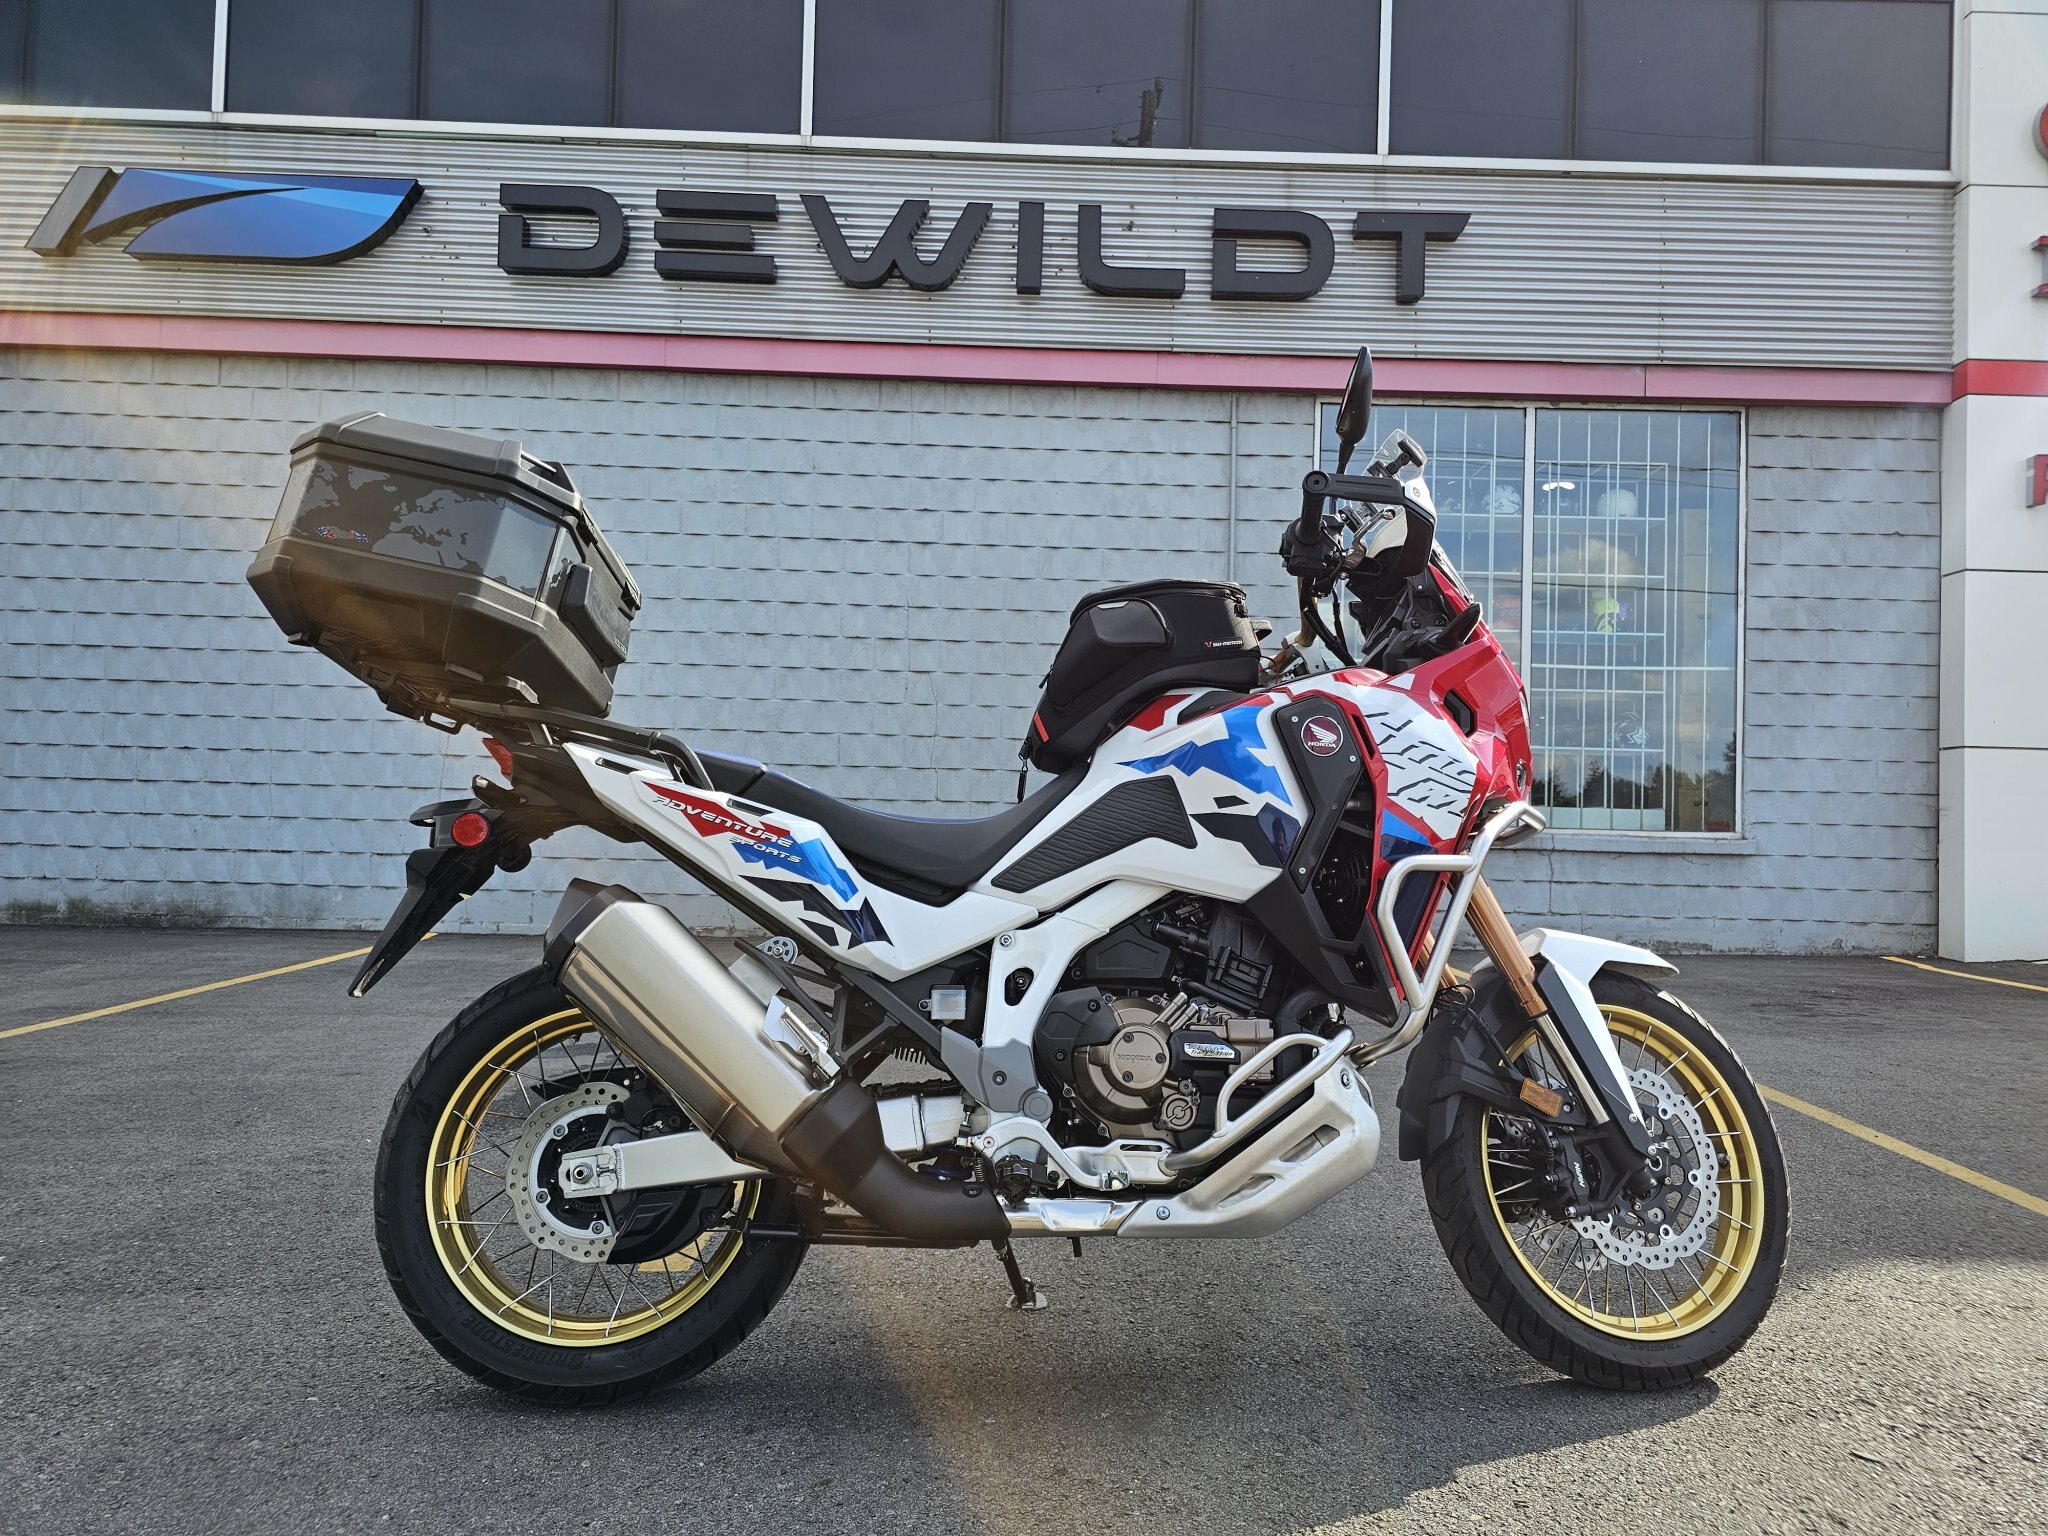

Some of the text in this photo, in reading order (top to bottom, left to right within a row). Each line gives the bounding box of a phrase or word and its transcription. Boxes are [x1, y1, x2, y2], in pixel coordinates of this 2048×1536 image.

[497, 182, 1472, 305] DEWILDT
[1212, 639, 1243, 648] SW-MOTECH
[1307, 741, 1337, 749] HONDA
[652, 794, 795, 849] ADVENTURE
[728, 835, 803, 863] SPORTS
